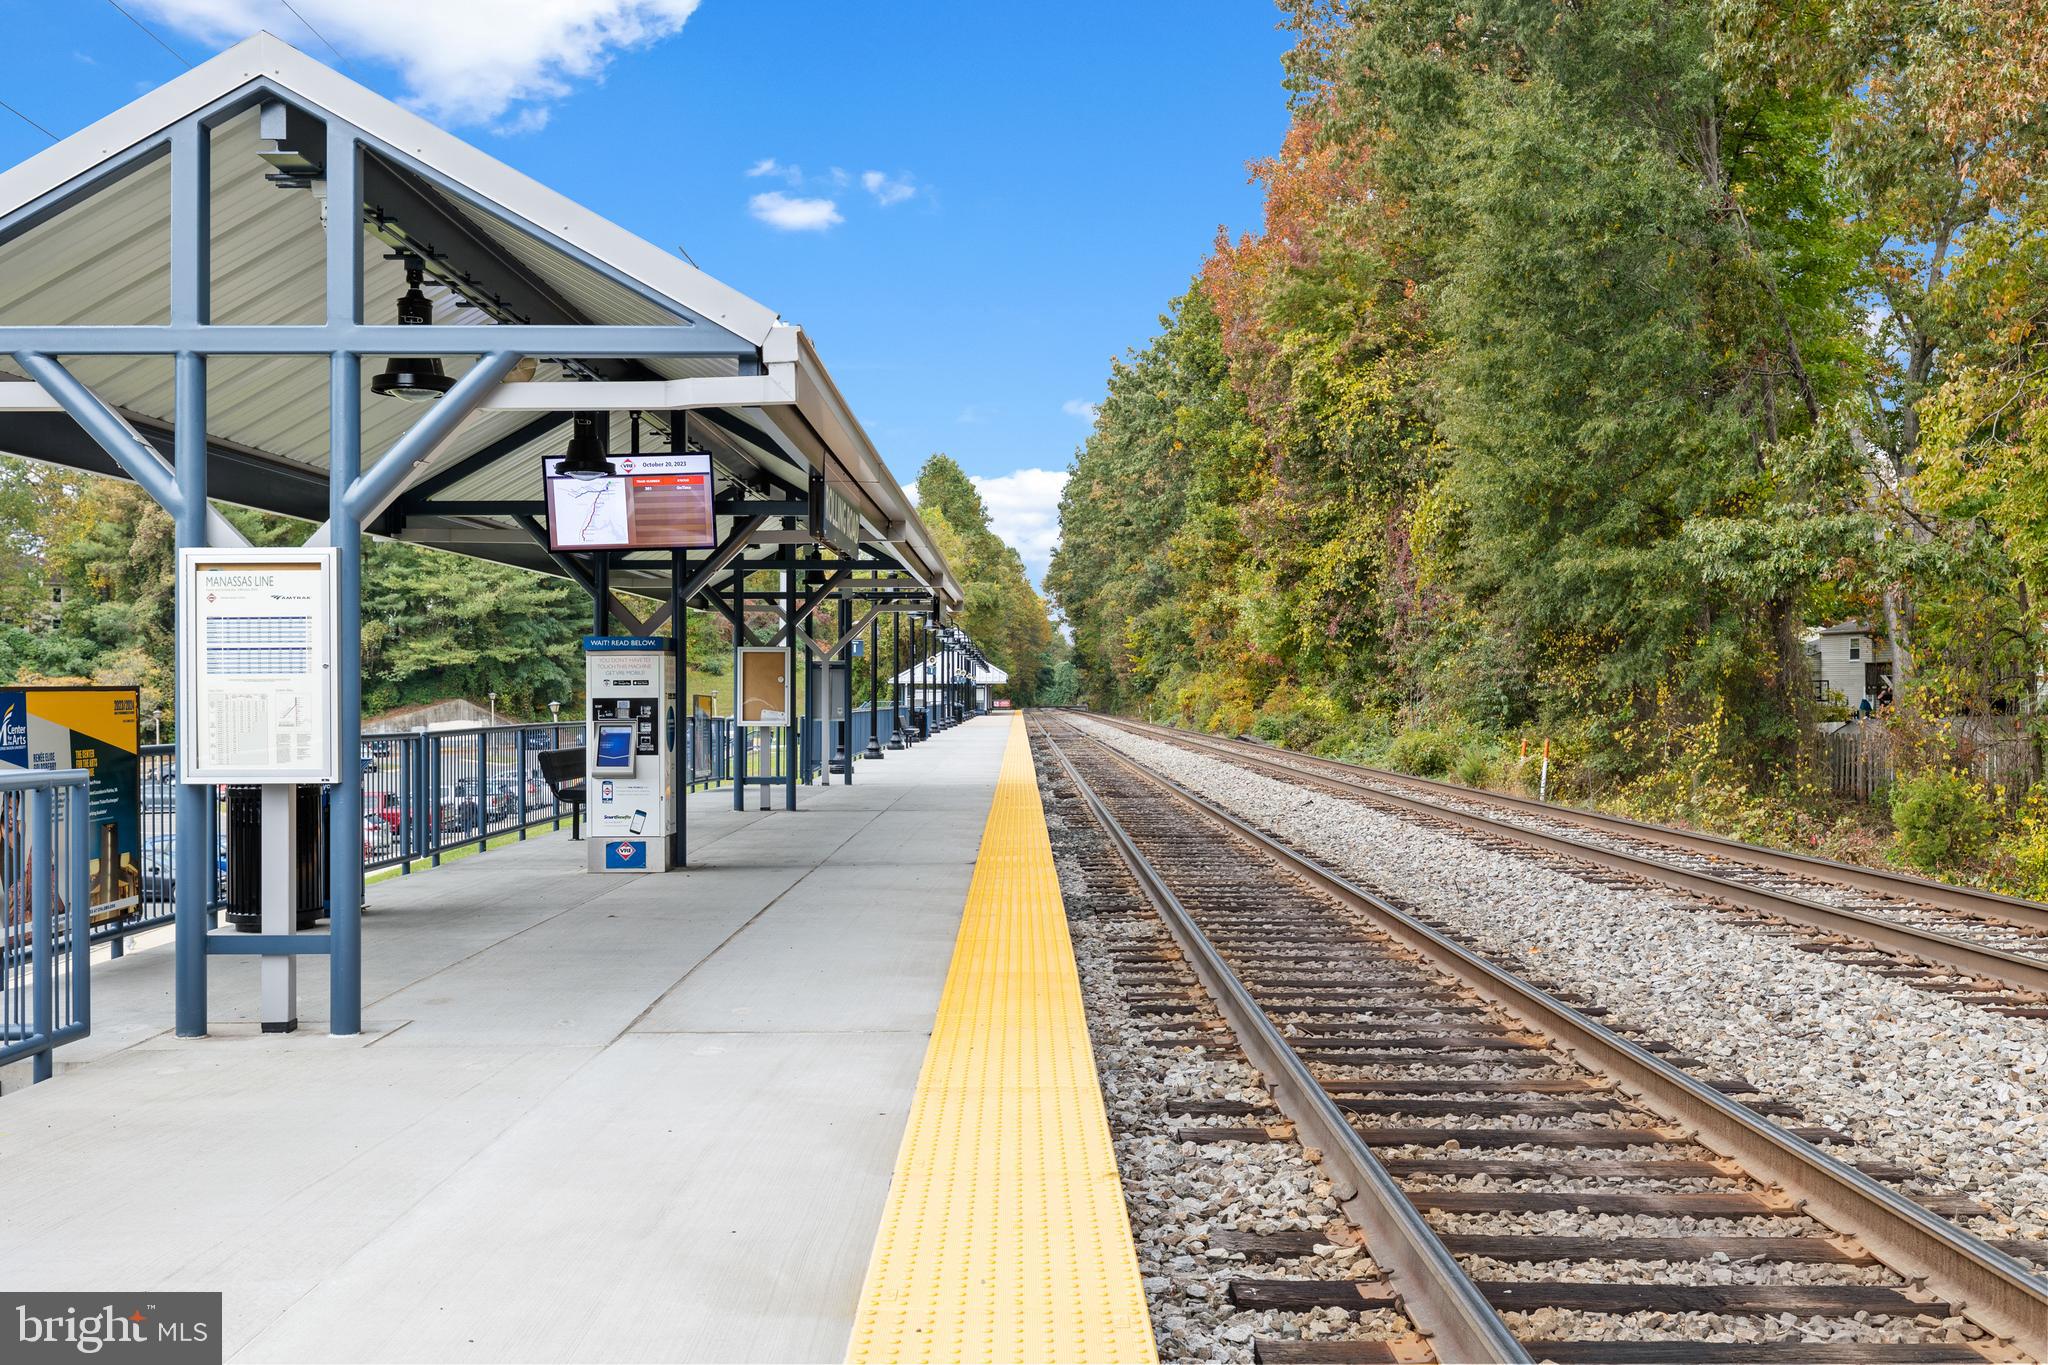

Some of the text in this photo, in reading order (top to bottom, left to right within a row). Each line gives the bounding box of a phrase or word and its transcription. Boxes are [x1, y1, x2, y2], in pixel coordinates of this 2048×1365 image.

[206, 576, 274, 586] MANASSAS LINE
[8, 724, 26, 734] Center
[13, 735, 26, 745] Arts
